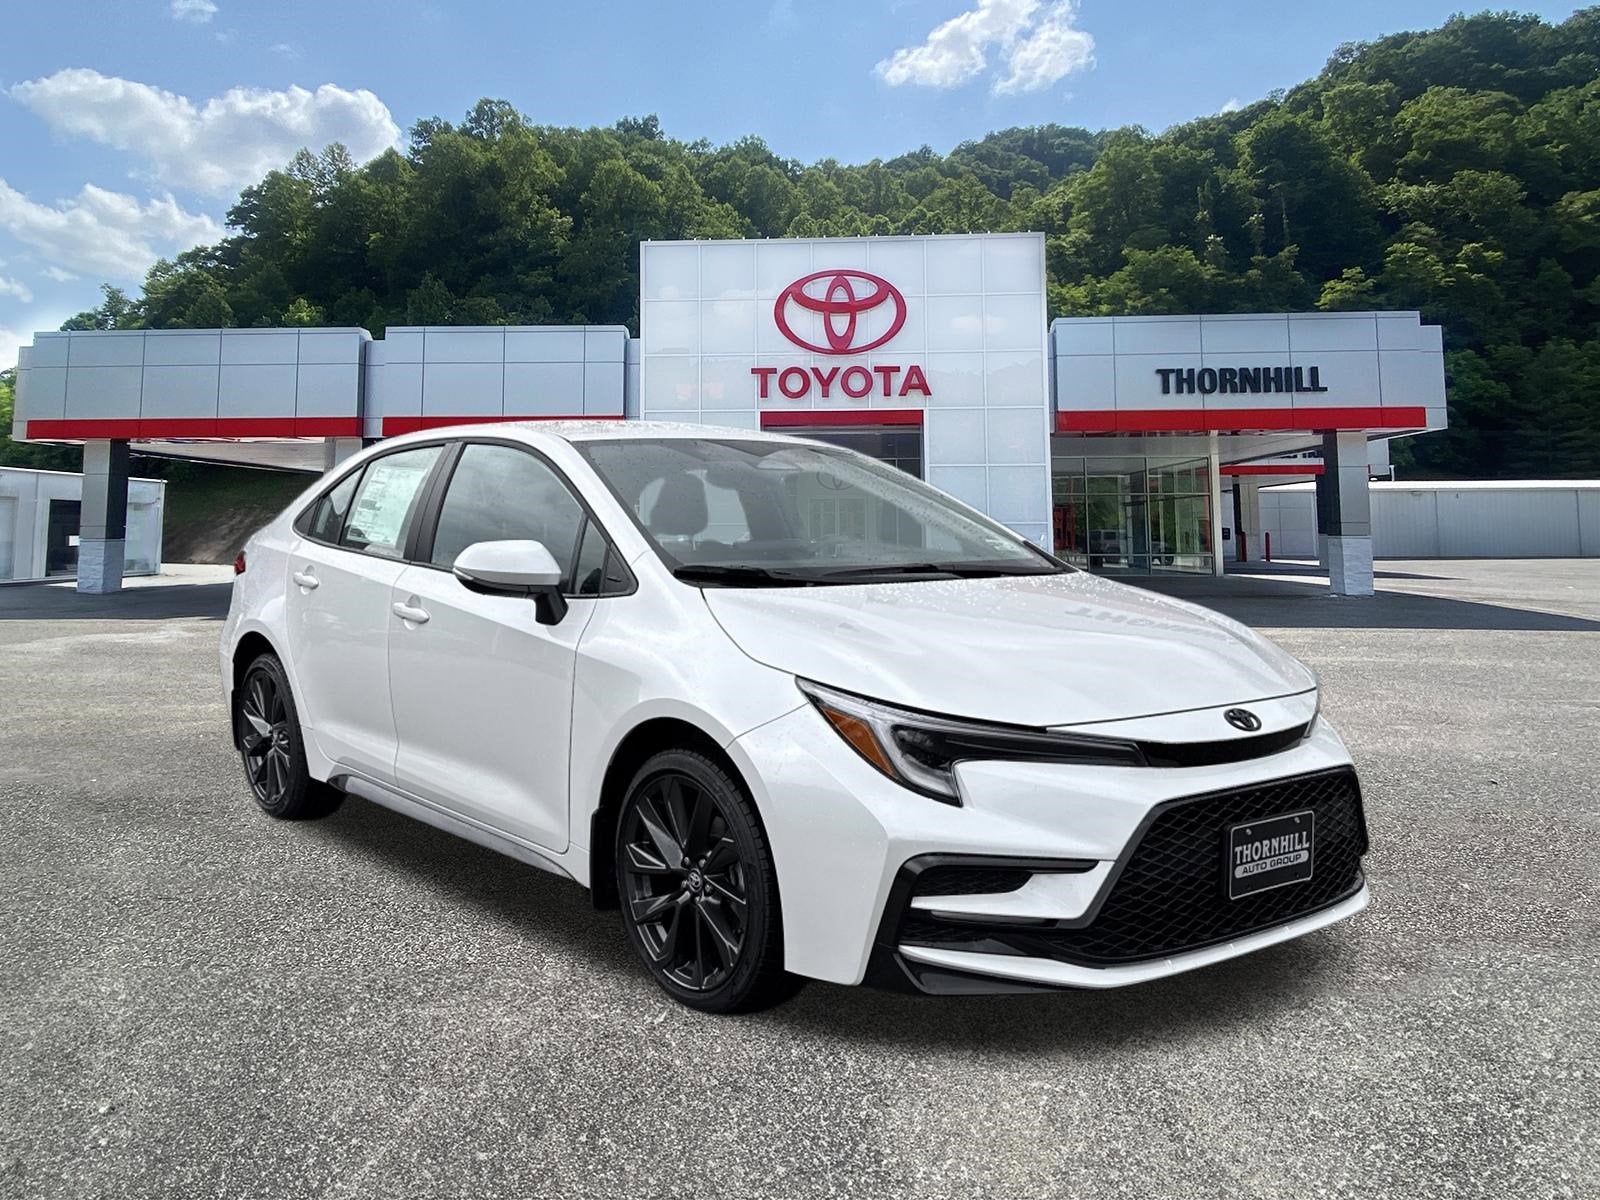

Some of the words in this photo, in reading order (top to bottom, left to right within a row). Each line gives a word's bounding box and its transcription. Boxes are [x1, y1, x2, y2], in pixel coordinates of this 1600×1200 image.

[751, 365, 932, 399] TOYOTA
[1155, 366, 1328, 394] THORNHILL
[1234, 831, 1310, 865] THORNHILL
[1242, 861, 1268, 875] AUTO
[1269, 853, 1302, 868] GROUP
